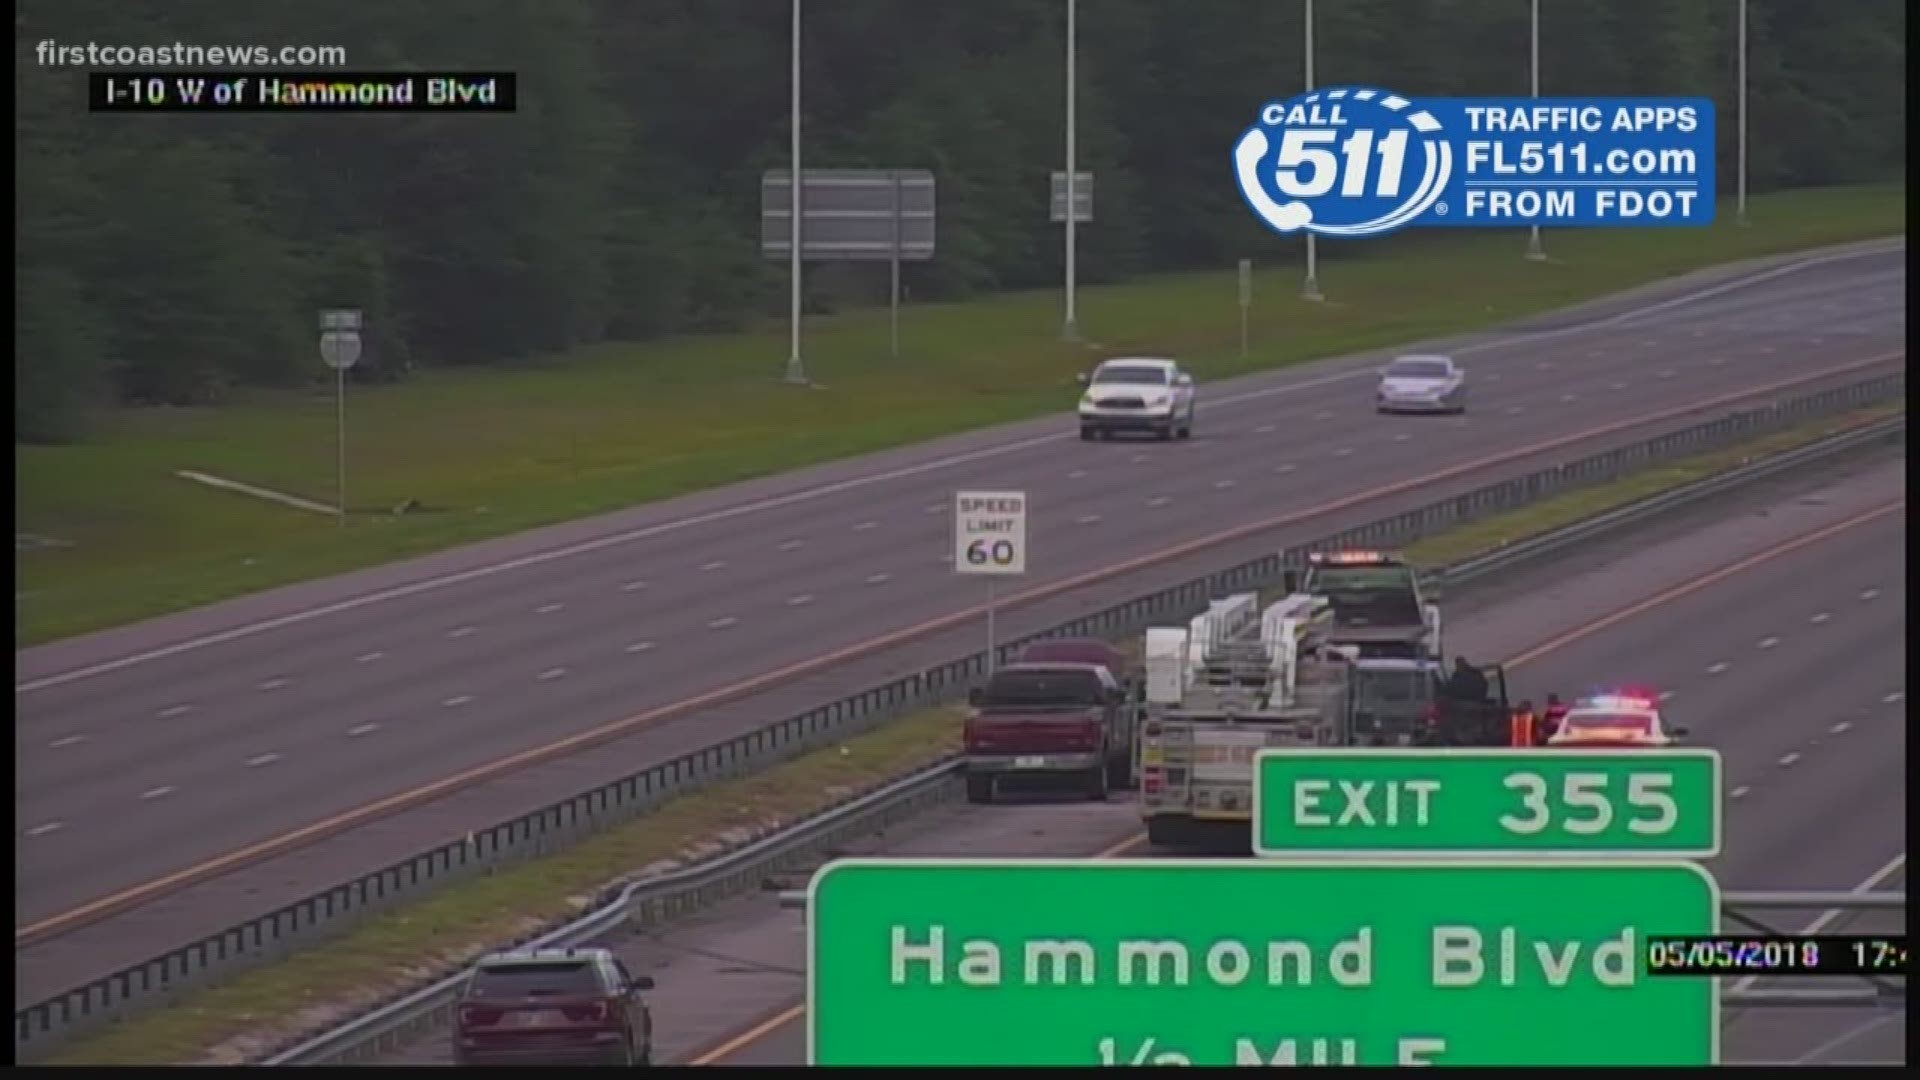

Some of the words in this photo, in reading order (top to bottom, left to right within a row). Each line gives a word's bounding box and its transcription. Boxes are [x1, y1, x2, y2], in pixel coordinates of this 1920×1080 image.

[960, 497, 1021, 513] SPEED
[966, 518, 1014, 533] LIMIT
[966, 538, 1014, 566] 60
[1294, 779, 1440, 827] EXIT
[1501, 774, 1679, 835] 355
[891, 926, 1373, 986] Hammond
[1433, 926, 1635, 986] Blvd
